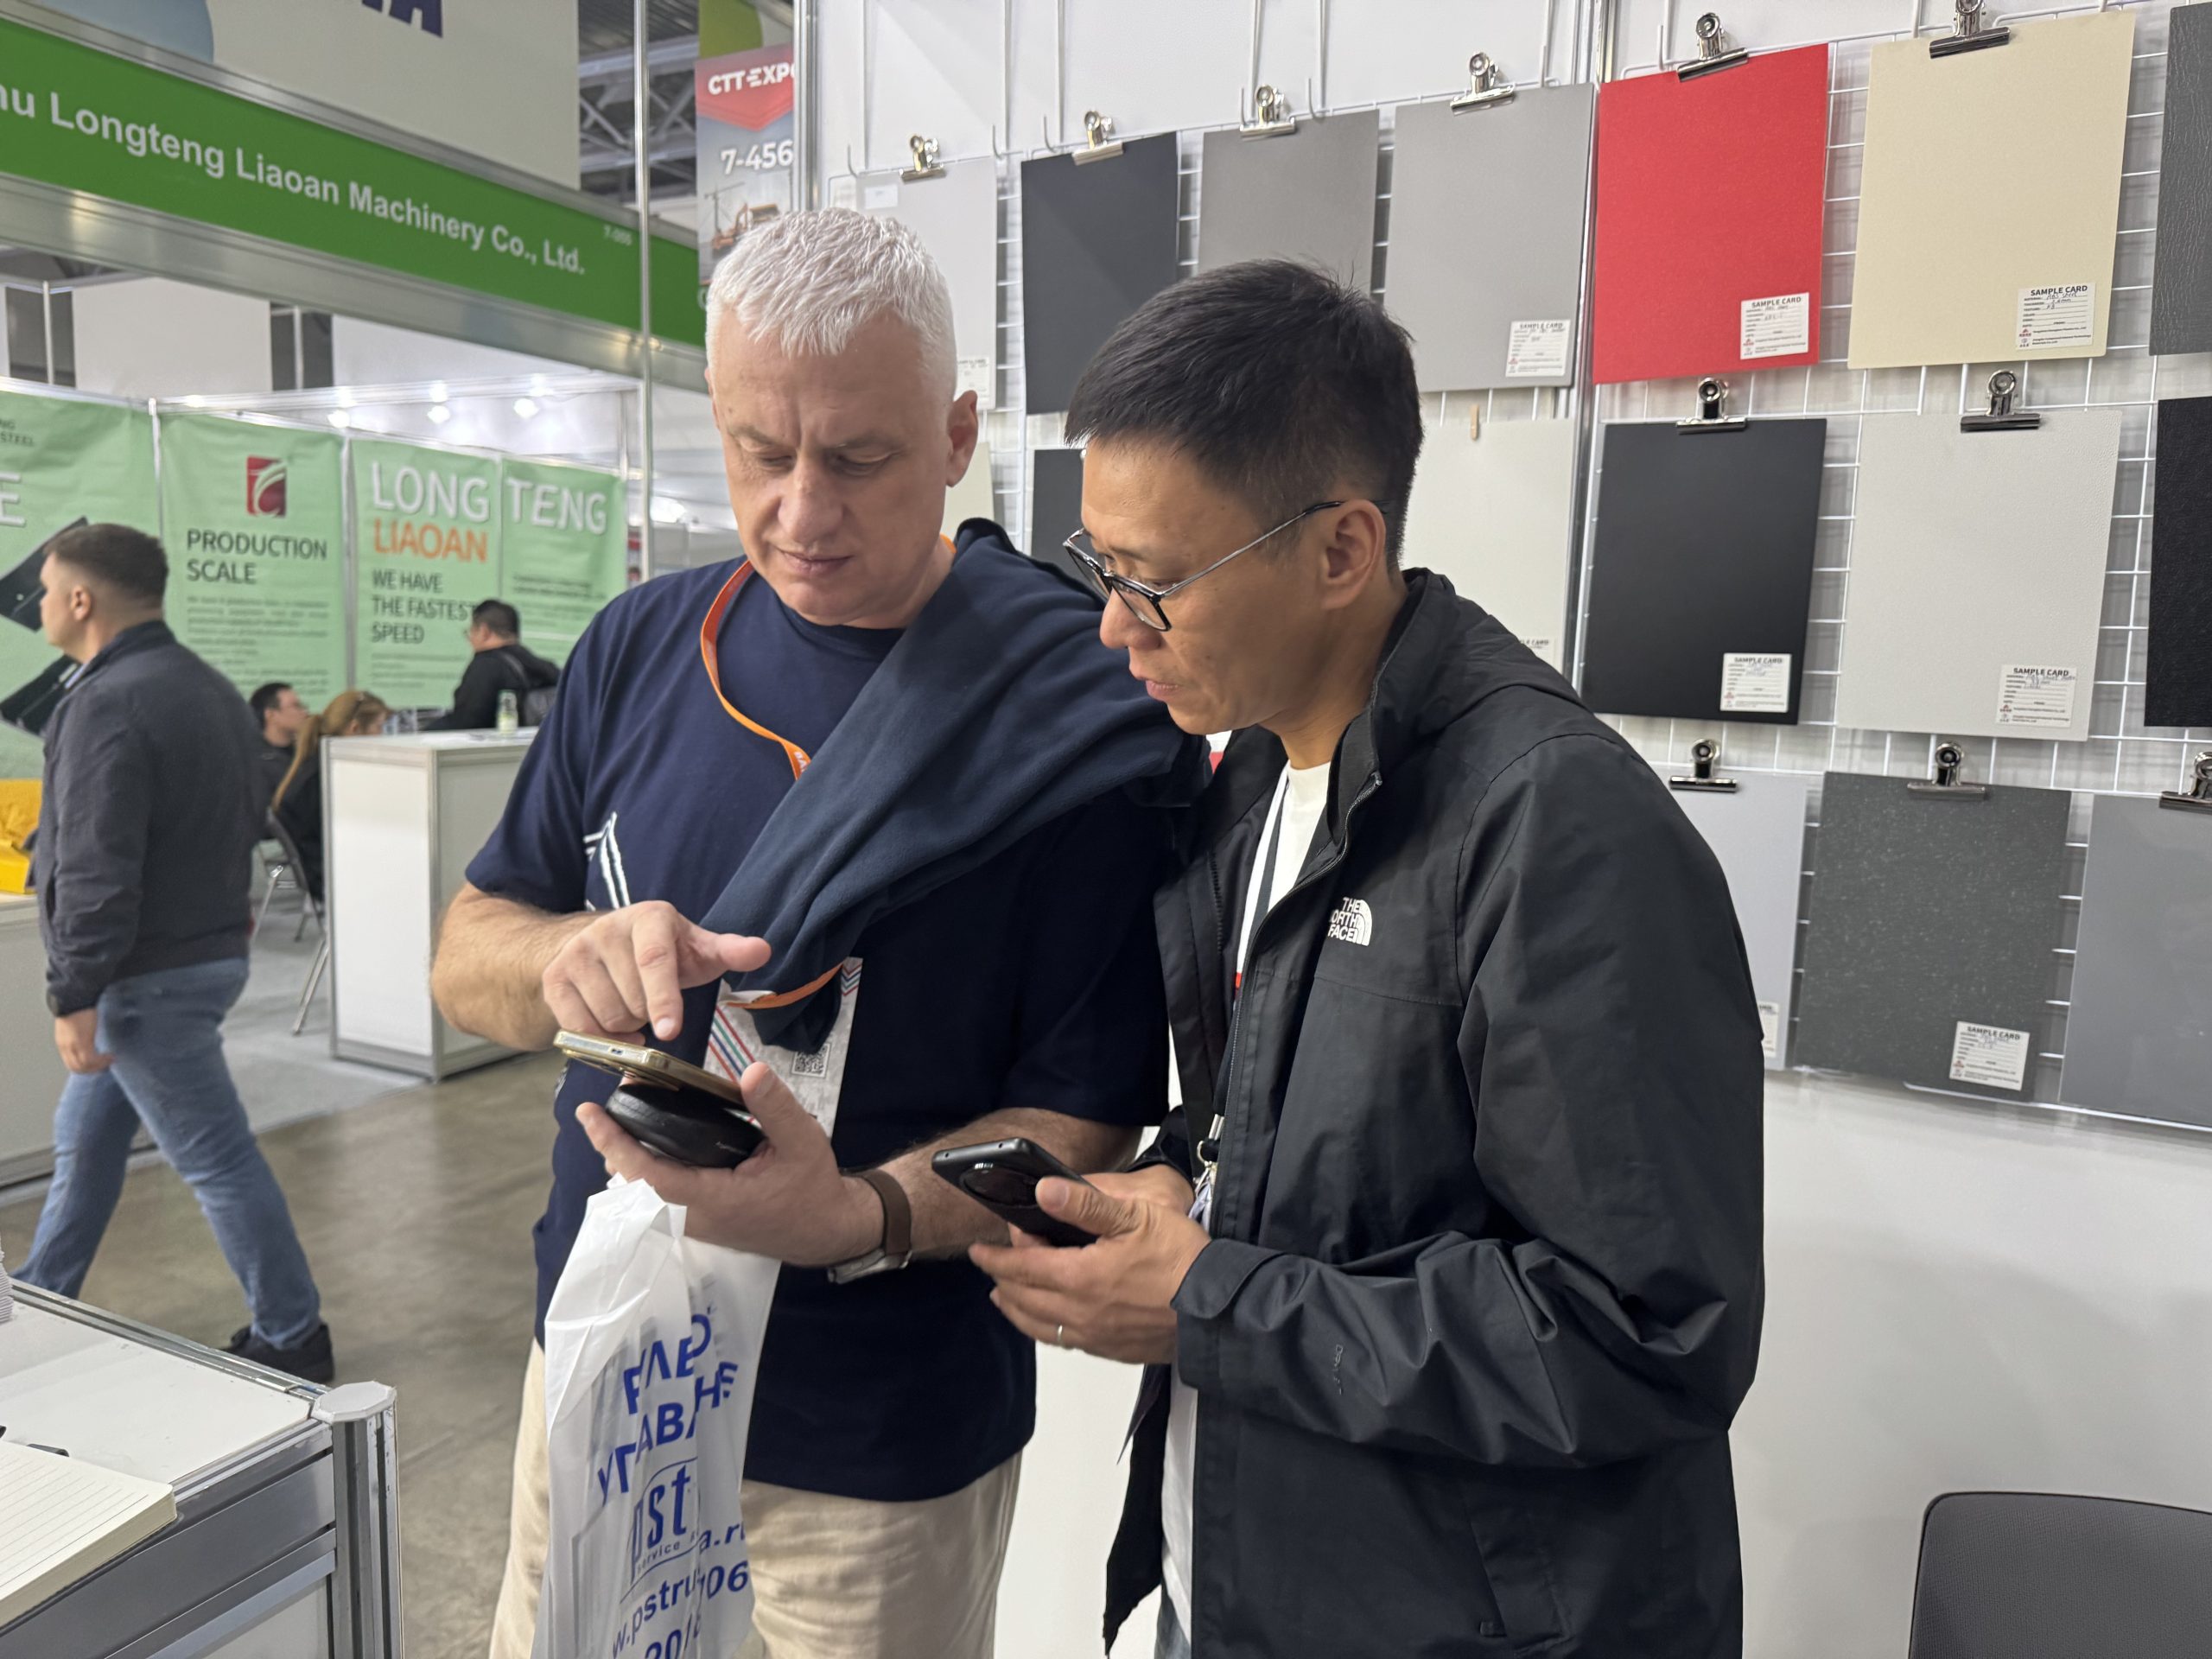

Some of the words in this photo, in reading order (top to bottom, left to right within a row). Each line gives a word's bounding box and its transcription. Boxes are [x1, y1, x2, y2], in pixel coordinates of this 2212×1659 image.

[50, 91, 225, 179] Longteng
[236, 146, 340, 206] Liaoan
[349, 181, 485, 251] Machinery
[491, 225, 537, 265] Co.,
[543, 239, 585, 275] Ltd.
[2031, 287, 2063, 296] SAMPLE
[1751, 299, 1780, 308] SAMPLE
[371, 461, 492, 524] LONG
[505, 477, 607, 536] TENG
[186, 528, 327, 560] PRODUCTION
[373, 517, 489, 563] LIAOAN
[186, 558, 258, 585] SCALE
[372, 569, 397, 590] WE
[400, 570, 444, 594] HAVE
[372, 595, 405, 618] THE
[372, 620, 425, 645] SPEED
[2013, 667, 2045, 676] SAMPLE
[1343, 896, 1362, 913] THE
[1330, 909, 1357, 928] ORTH
[1327, 924, 1356, 943] FACE
[1967, 1026, 1998, 1037] SAMPLE
[1999, 1031, 2020, 1040] CARD
